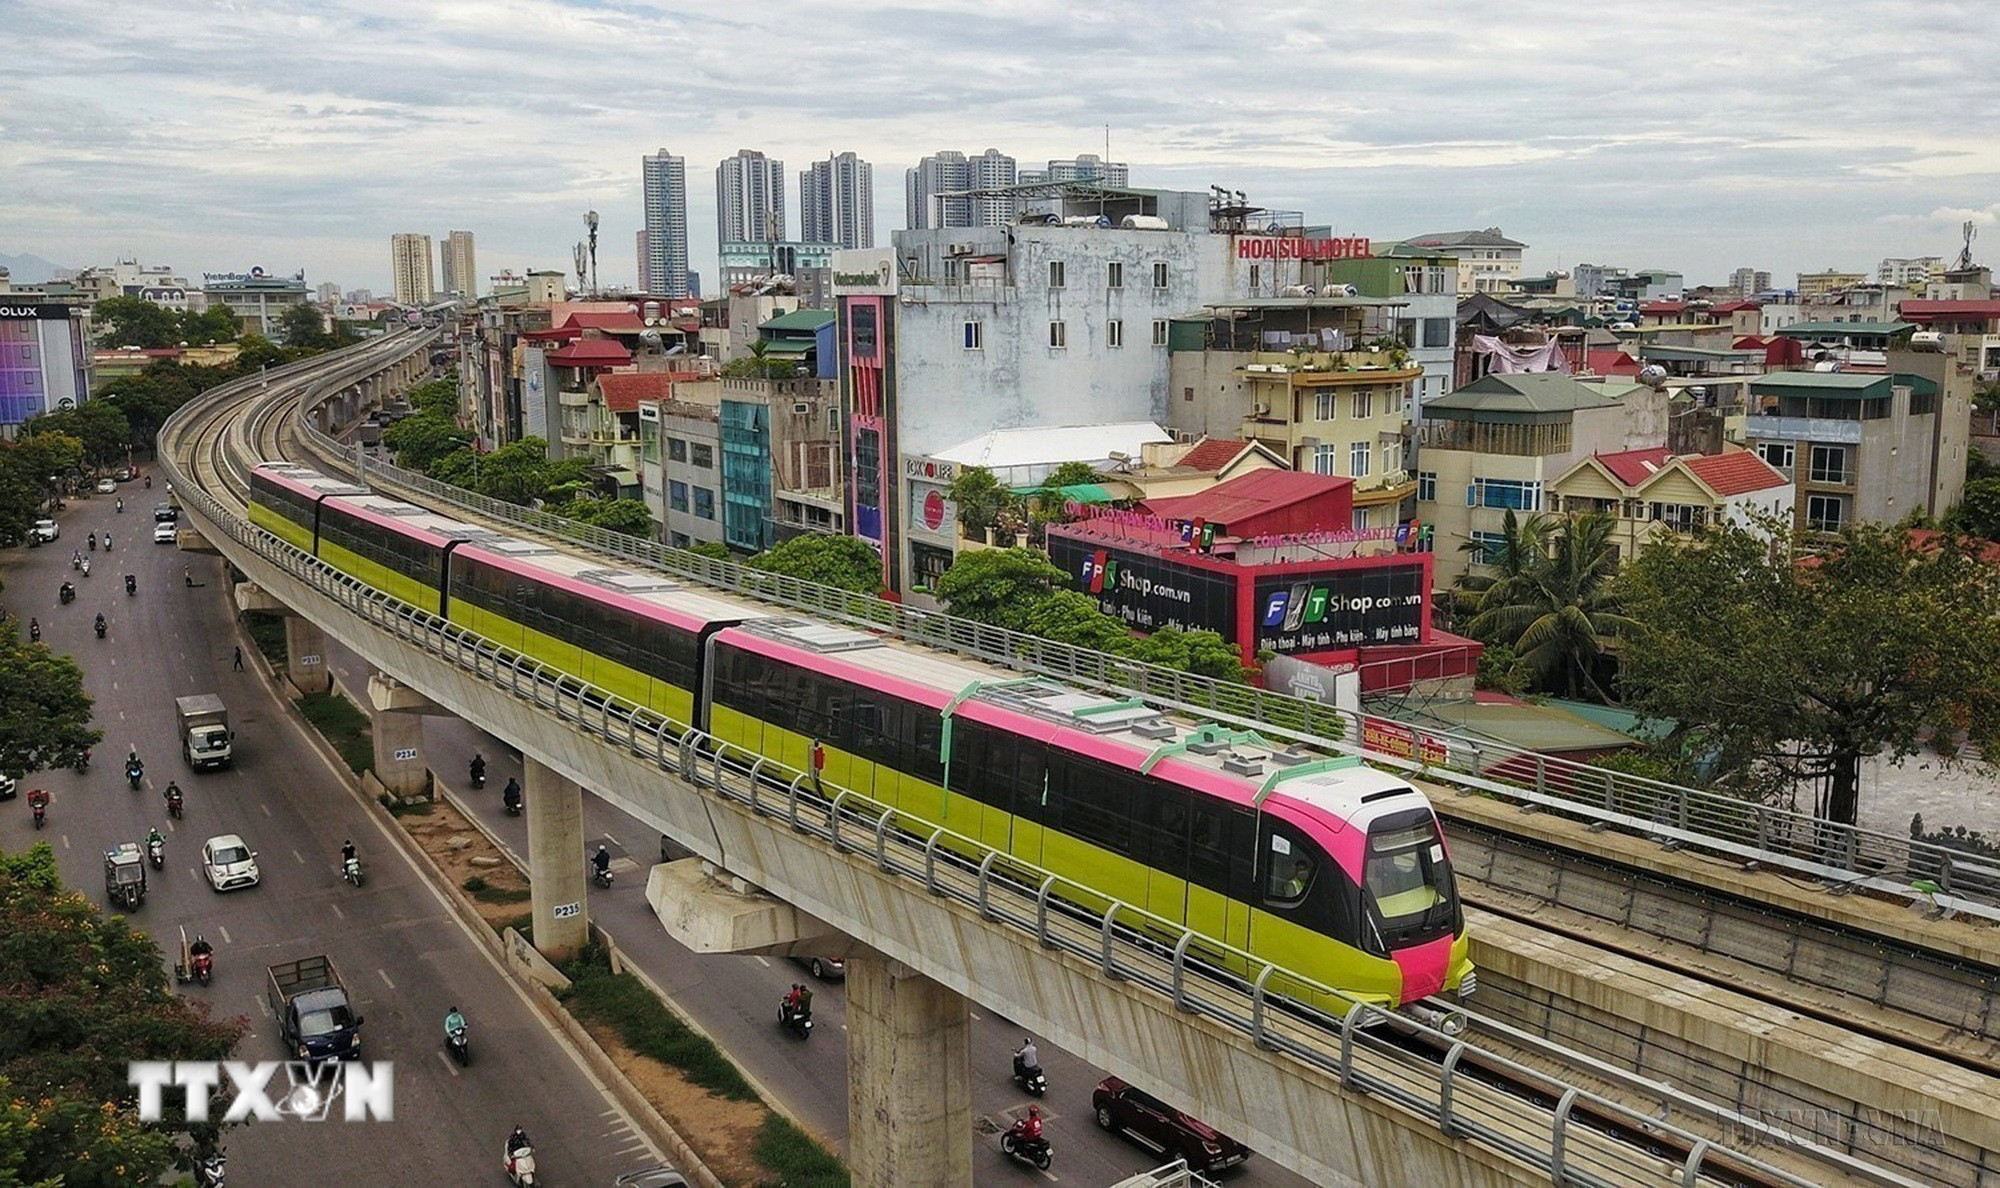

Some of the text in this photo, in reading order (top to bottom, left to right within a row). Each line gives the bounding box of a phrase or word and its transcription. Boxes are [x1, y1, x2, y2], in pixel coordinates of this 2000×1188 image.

[1239, 239, 1275, 258] HOA
[1320, 238, 1374, 259] HOTEL
[0, 307, 37, 316] OLUX
[1181, 520, 1213, 546] FPT
[1396, 522, 1431, 543] FPT
[1330, 594, 1373, 614] Shop
[555, 903, 580, 916] P235
